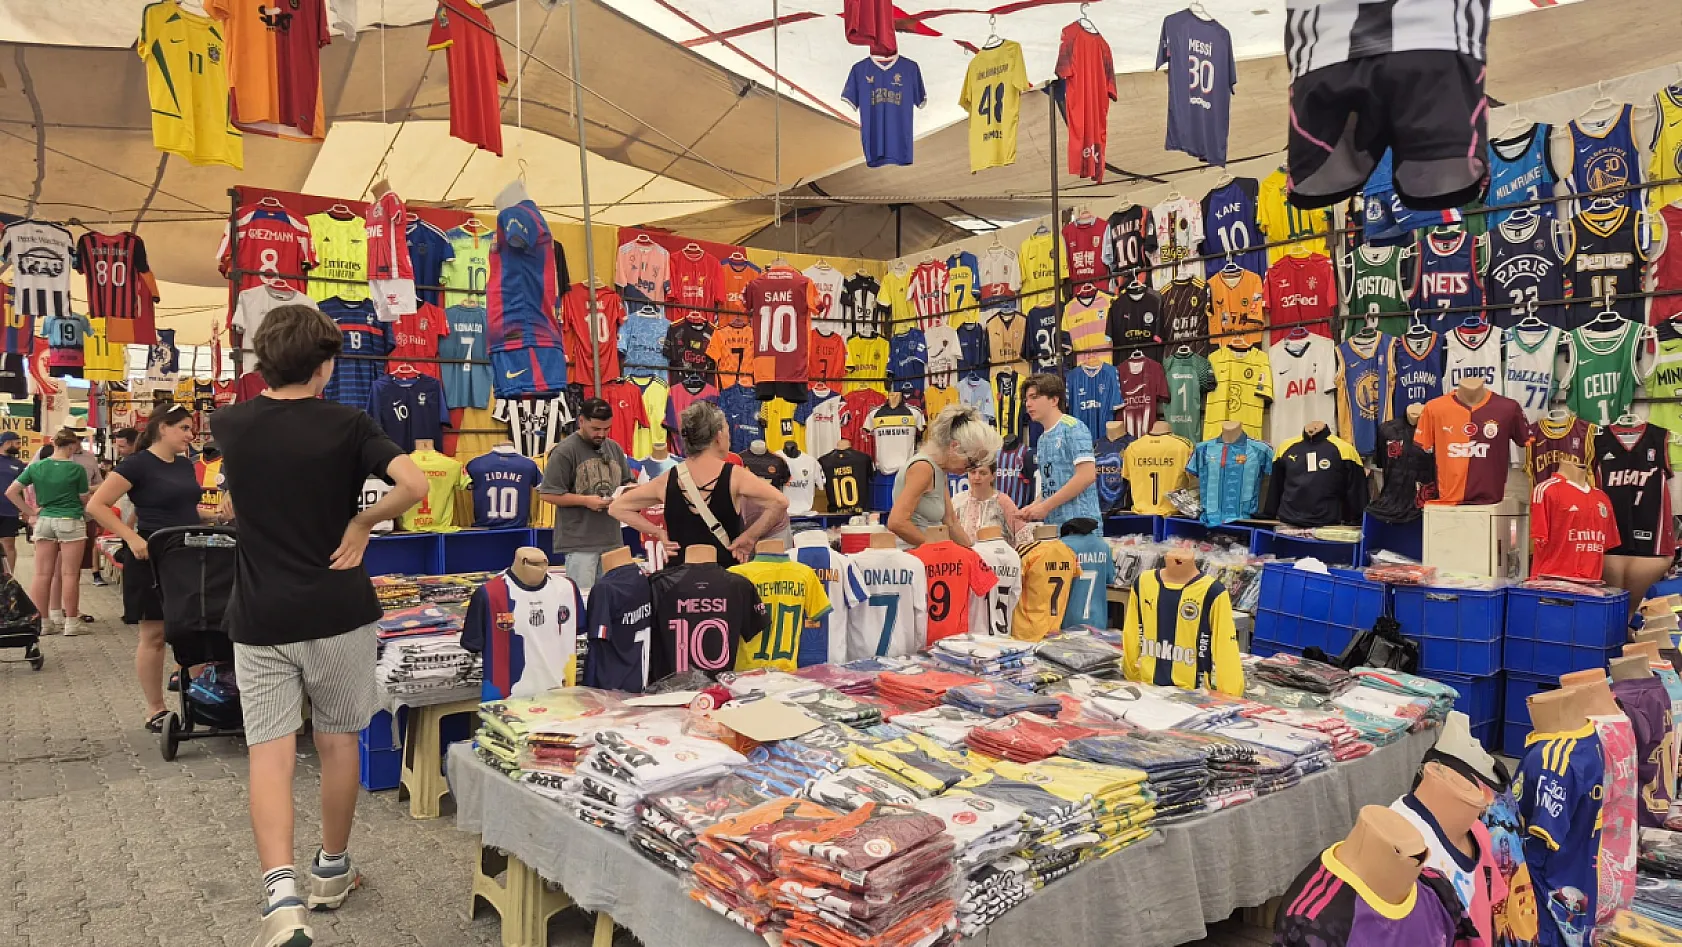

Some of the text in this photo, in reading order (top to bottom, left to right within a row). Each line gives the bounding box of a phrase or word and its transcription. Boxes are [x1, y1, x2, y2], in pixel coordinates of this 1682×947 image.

[188, 51, 203, 74] 11
[1188, 55, 1215, 94] 30
[978, 82, 1004, 125] 48
[1602, 158, 1619, 173] 30
[1215, 201, 1242, 221] KANE
[1217, 220, 1250, 256] 10
[1116, 235, 1139, 268] 10
[95, 259, 127, 287] 80
[259, 248, 279, 285] 8
[1495, 259, 1549, 284] PARIS
[764, 289, 793, 302] SANÉ
[953, 284, 965, 309] 7
[1355, 274, 1397, 299] BOSTON
[1422, 273, 1469, 300] NETS
[1590, 274, 1617, 307] 15
[1437, 298, 1451, 321] 7
[1508, 285, 1539, 316] 23
[59, 322, 75, 342] 19
[585, 311, 610, 344] 10
[758, 304, 798, 353] 10
[460, 336, 476, 371] 7
[1285, 377, 1317, 399] AIA
[1400, 375, 1436, 388] OKLAHOMA
[1507, 368, 1550, 385] DALLAS
[1178, 382, 1187, 412] 1
[1408, 386, 1426, 400] CITY
[1524, 385, 1548, 410] 77
[0, 418, 20, 430] NY
[393, 404, 410, 422] 10
[877, 427, 910, 438] SAMSUNG
[834, 466, 853, 476] MESSI
[1137, 457, 1176, 468] CASILLAS
[484, 471, 523, 484] ZIDANE
[1150, 471, 1158, 506] 1
[1607, 466, 1658, 488] HEAT
[487, 486, 519, 520] 10
[832, 475, 859, 509] 10
[1633, 490, 1644, 506] 1
[1079, 551, 1107, 564] ONALD
[863, 568, 914, 587] ONALD
[677, 598, 727, 614] MESSI
[928, 580, 952, 622] 9
[1047, 576, 1064, 617] 7
[1079, 570, 1097, 620] 7
[754, 602, 802, 661] 10
[868, 594, 900, 656] 7
[668, 617, 730, 672] 10
[1198, 632, 1210, 658] PORT
